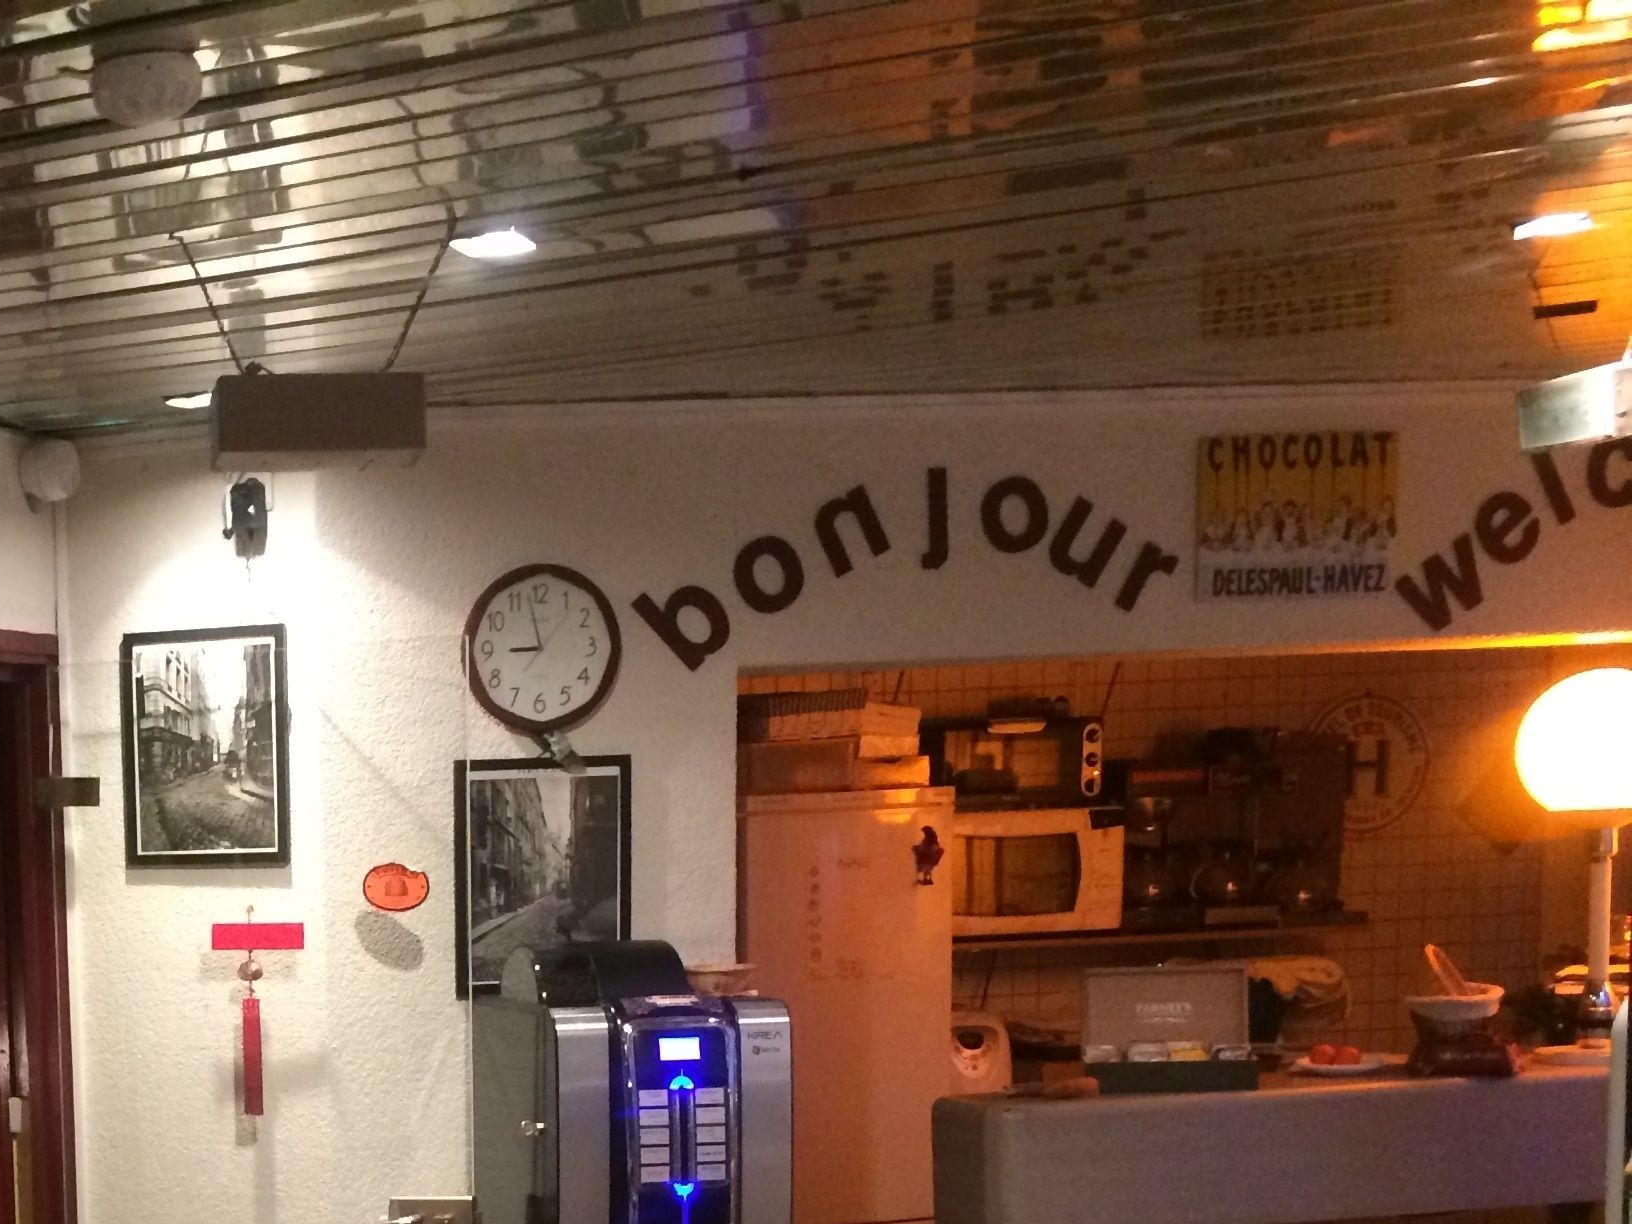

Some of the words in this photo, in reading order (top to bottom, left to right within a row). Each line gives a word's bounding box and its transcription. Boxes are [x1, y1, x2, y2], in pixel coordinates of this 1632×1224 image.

[1206, 431, 1394, 473] CHOCOLAT
[1212, 562, 1387, 598] DELESPAUL-HAVEZ
[508, 591, 522, 612] 11
[532, 583, 549, 604] 12
[487, 611, 505, 632] 10
[579, 608, 590, 628] 2
[480, 640, 494, 661] 9
[585, 636, 597, 657] 3
[488, 668, 501, 689] 8
[576, 667, 590, 686] 4
[510, 687, 520, 707] 7
[533, 693, 546, 714] 6
[559, 685, 572, 706] 5
[1344, 738, 1391, 798] H
